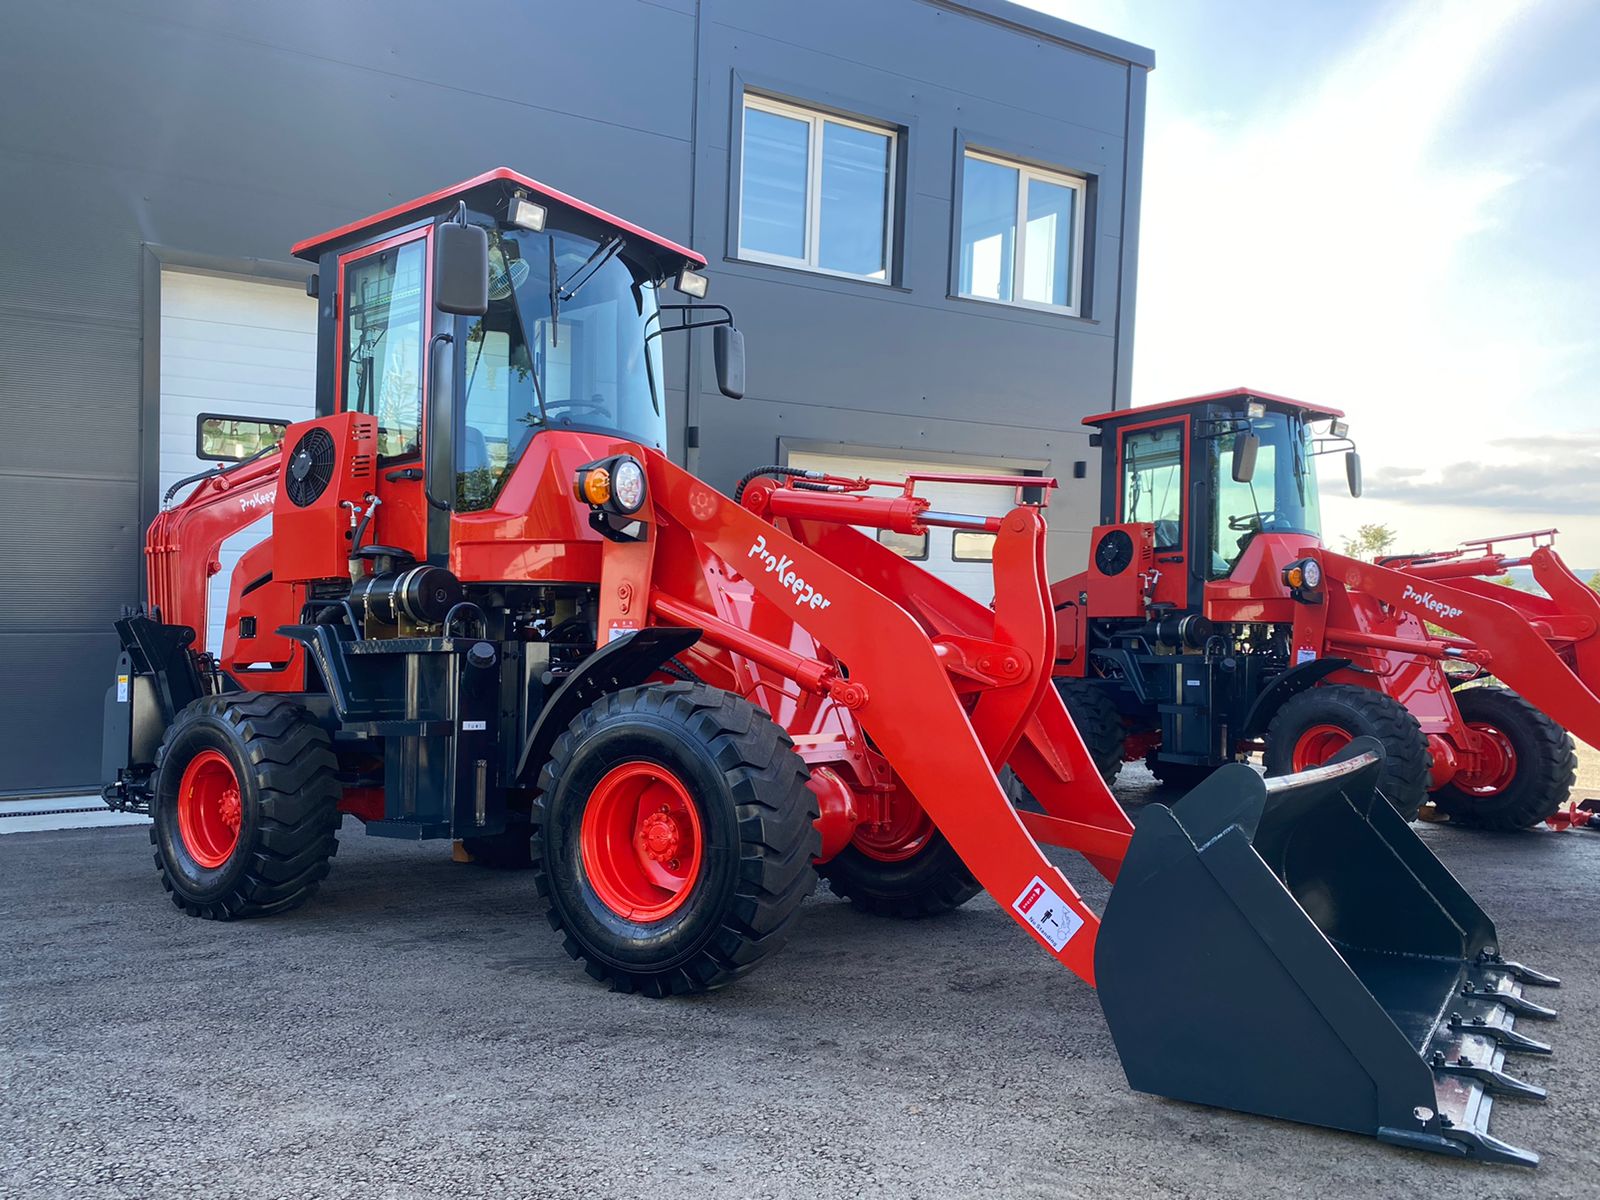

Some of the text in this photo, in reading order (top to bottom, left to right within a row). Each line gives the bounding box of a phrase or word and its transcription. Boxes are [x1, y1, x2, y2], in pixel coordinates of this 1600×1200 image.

[239, 490, 277, 512] ProKeep
[747, 534, 831, 609] ProKeeper
[1402, 584, 1463, 618] ProKeeper
